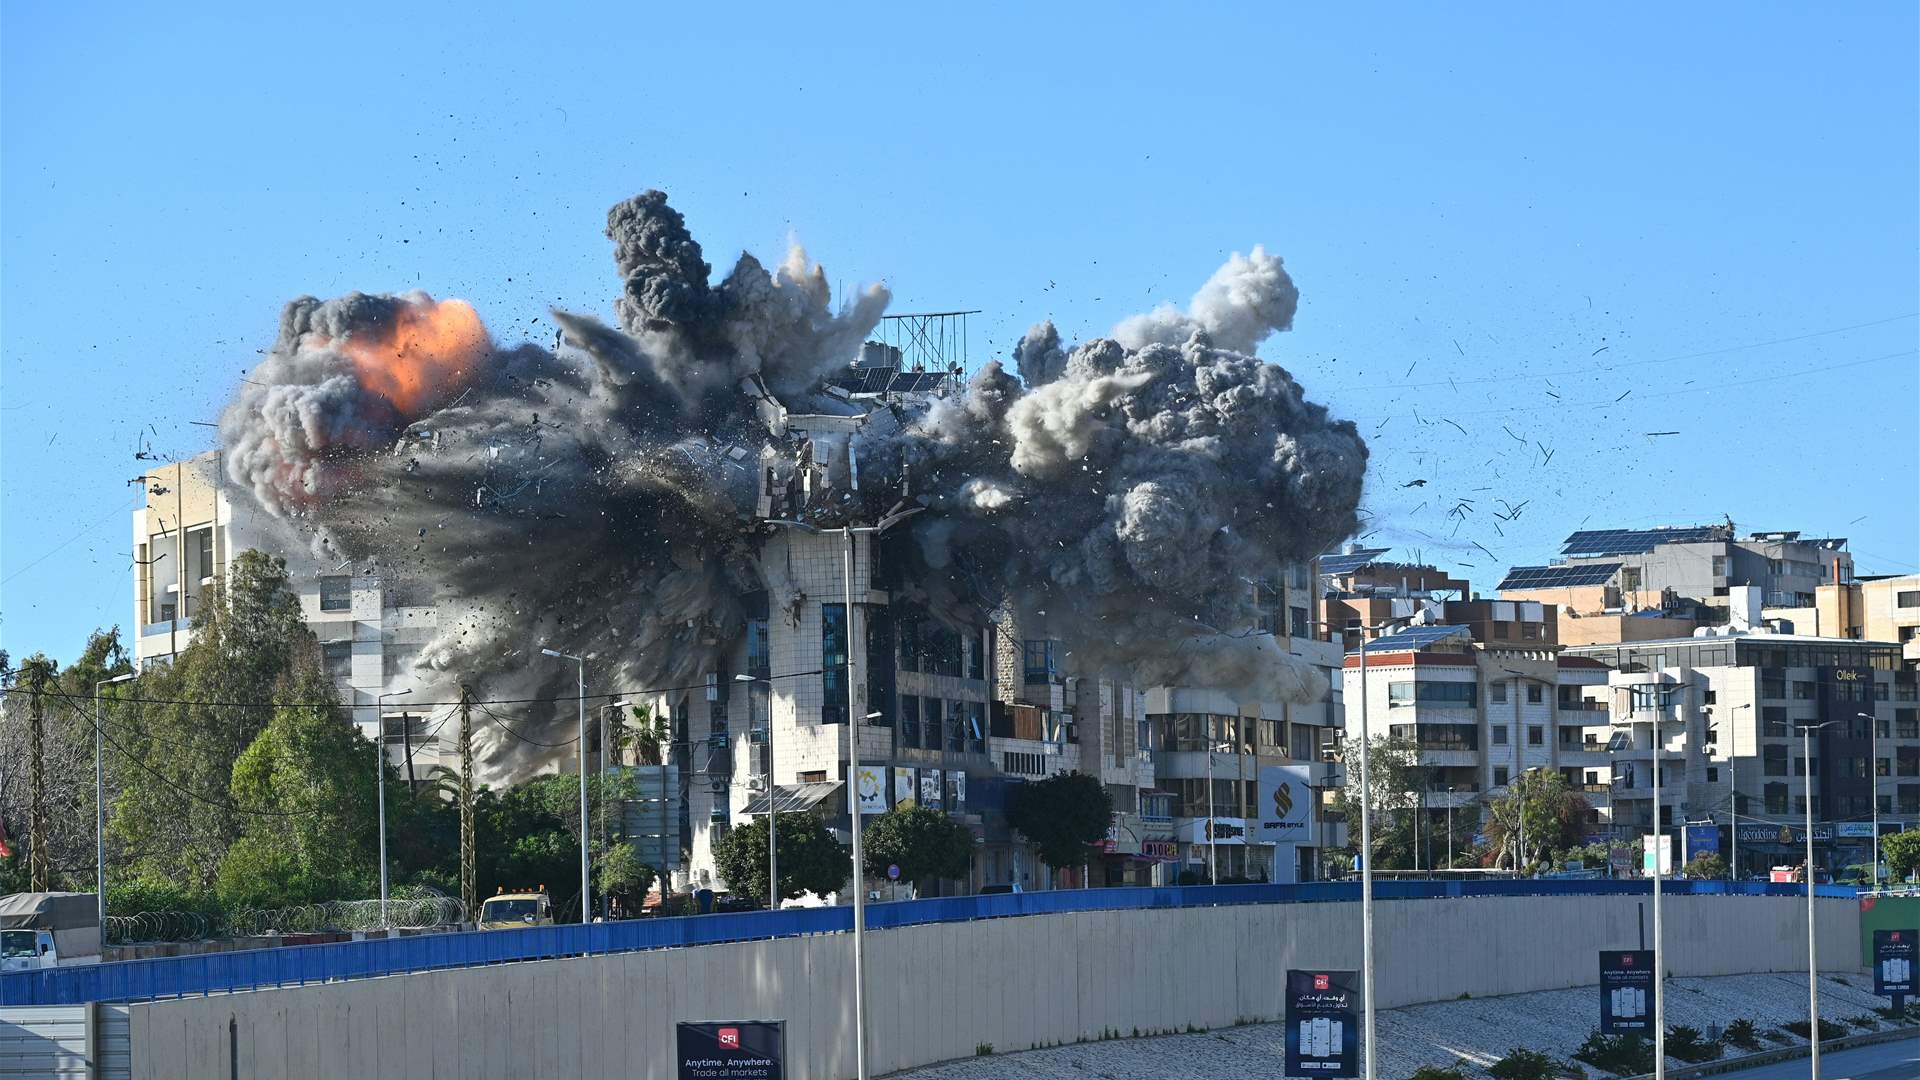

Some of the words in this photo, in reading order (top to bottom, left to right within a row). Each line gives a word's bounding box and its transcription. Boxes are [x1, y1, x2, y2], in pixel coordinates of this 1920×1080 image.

[721, 1035, 736, 1043] CFI
[685, 1058, 725, 1068] Anytime.
[727, 1058, 774, 1068] Anywhere.
[692, 1069, 717, 1077] Trade
[731, 1069, 768, 1077] markets
